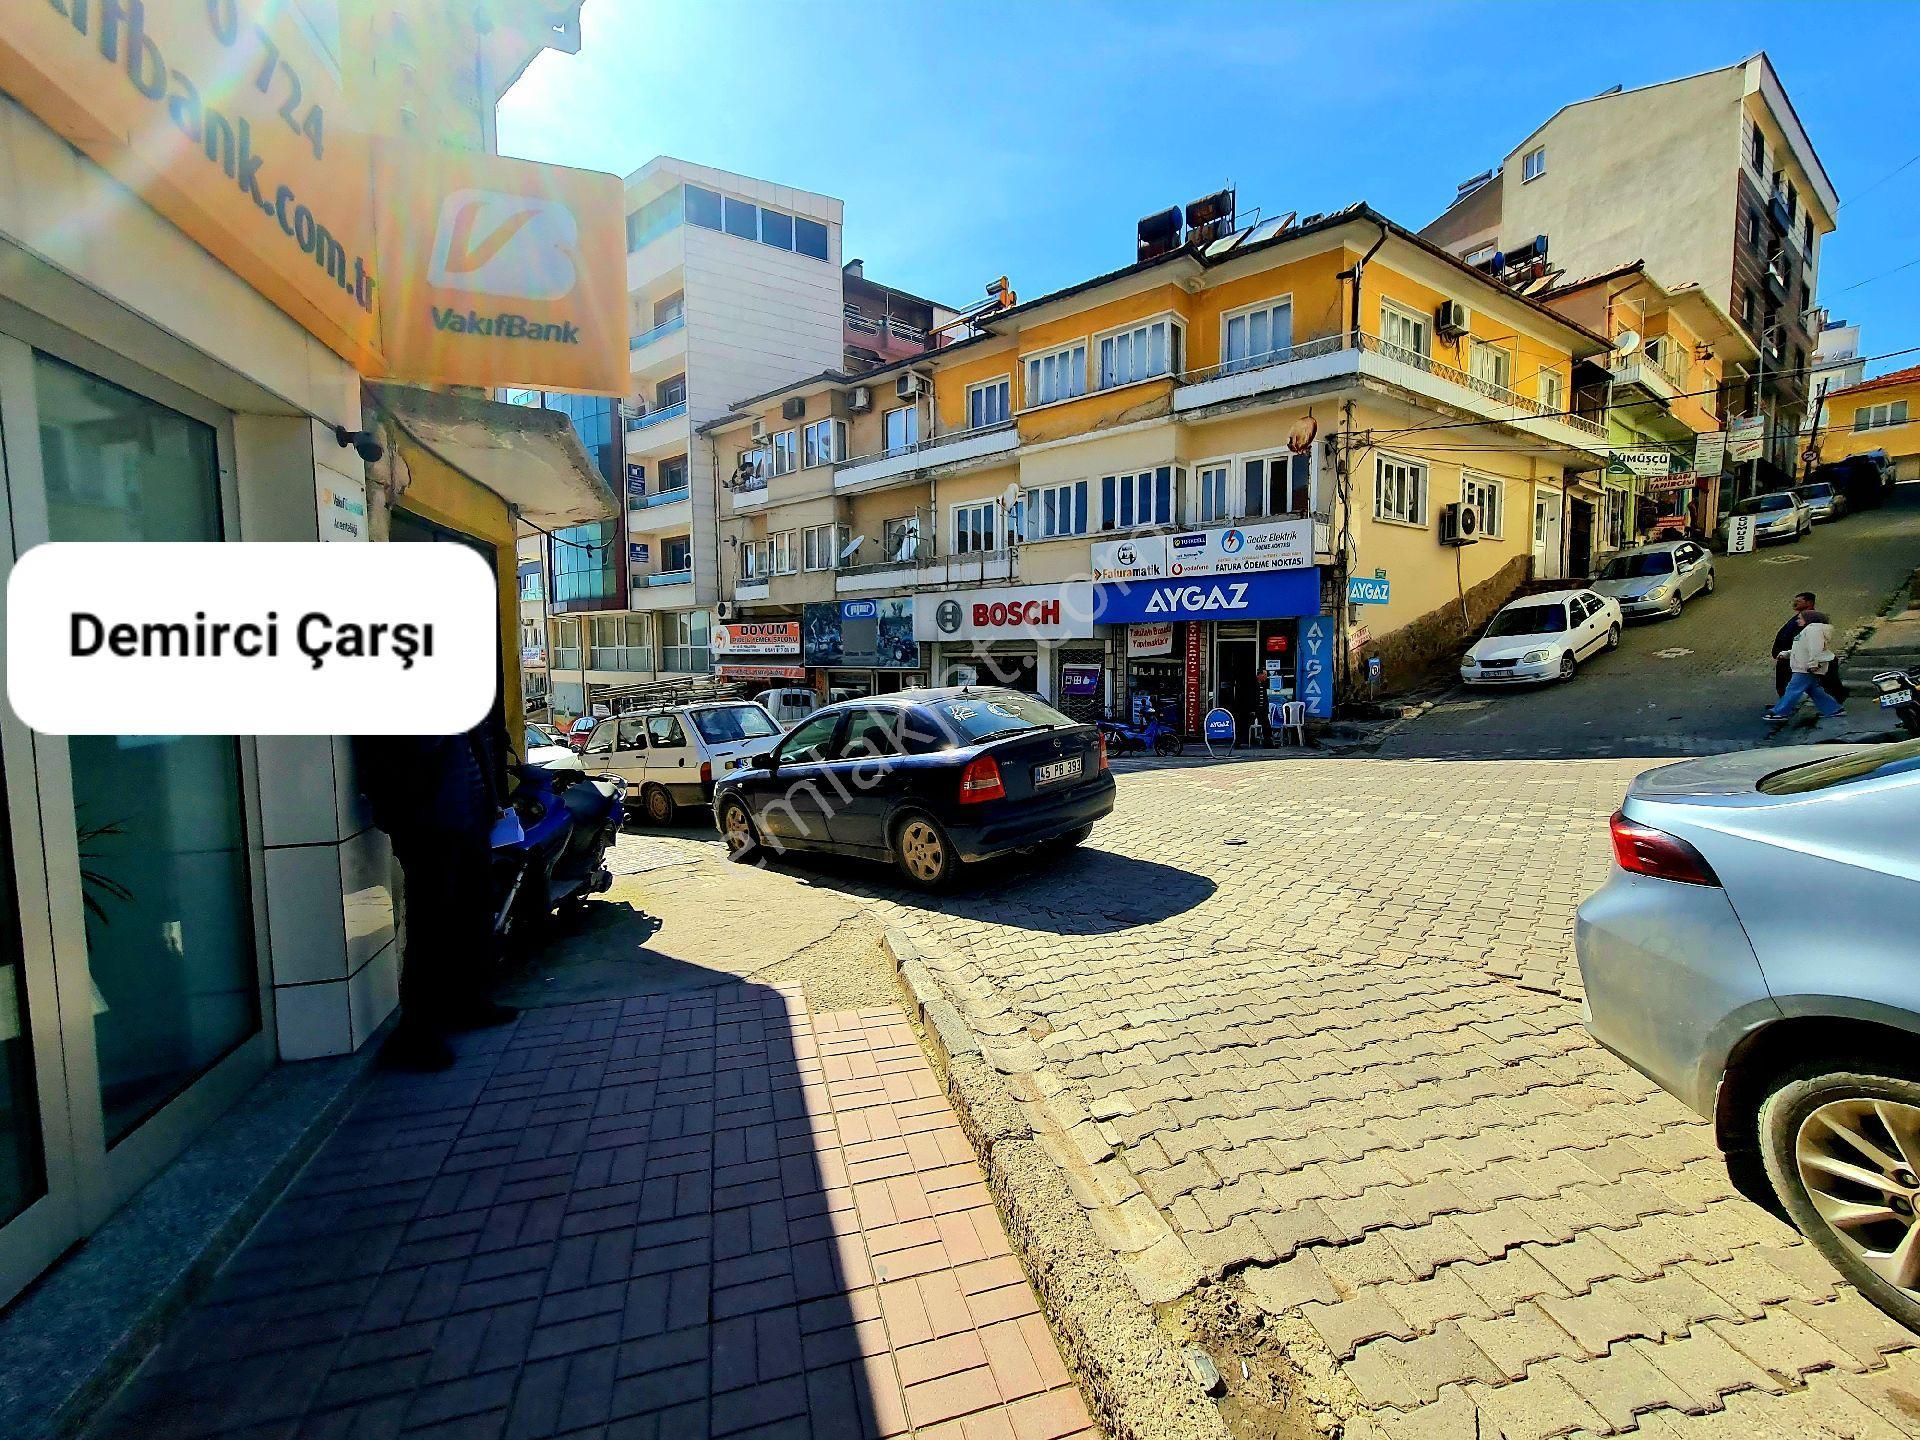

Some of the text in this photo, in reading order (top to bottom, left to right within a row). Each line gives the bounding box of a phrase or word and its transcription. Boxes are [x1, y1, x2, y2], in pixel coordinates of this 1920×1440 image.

[431, 306, 580, 345] VakıfBank
[1268, 531, 1297, 542] Elektrik
[1102, 564, 1161, 579] Faturamatik
[1215, 557, 1304, 572] FATURA ÖDEME NOKTASI
[1144, 582, 1249, 613] AYGAZ
[1349, 582, 1389, 600] AYGAZ
[972, 599, 1060, 627] BOSCH
[740, 623, 788, 636] DOYUM
[1304, 621, 1324, 714] AYGAZ
[1209, 720, 1230, 728] AYGAZ
[1040, 766, 1051, 779] 45
[1067, 759, 1081, 773] 393
